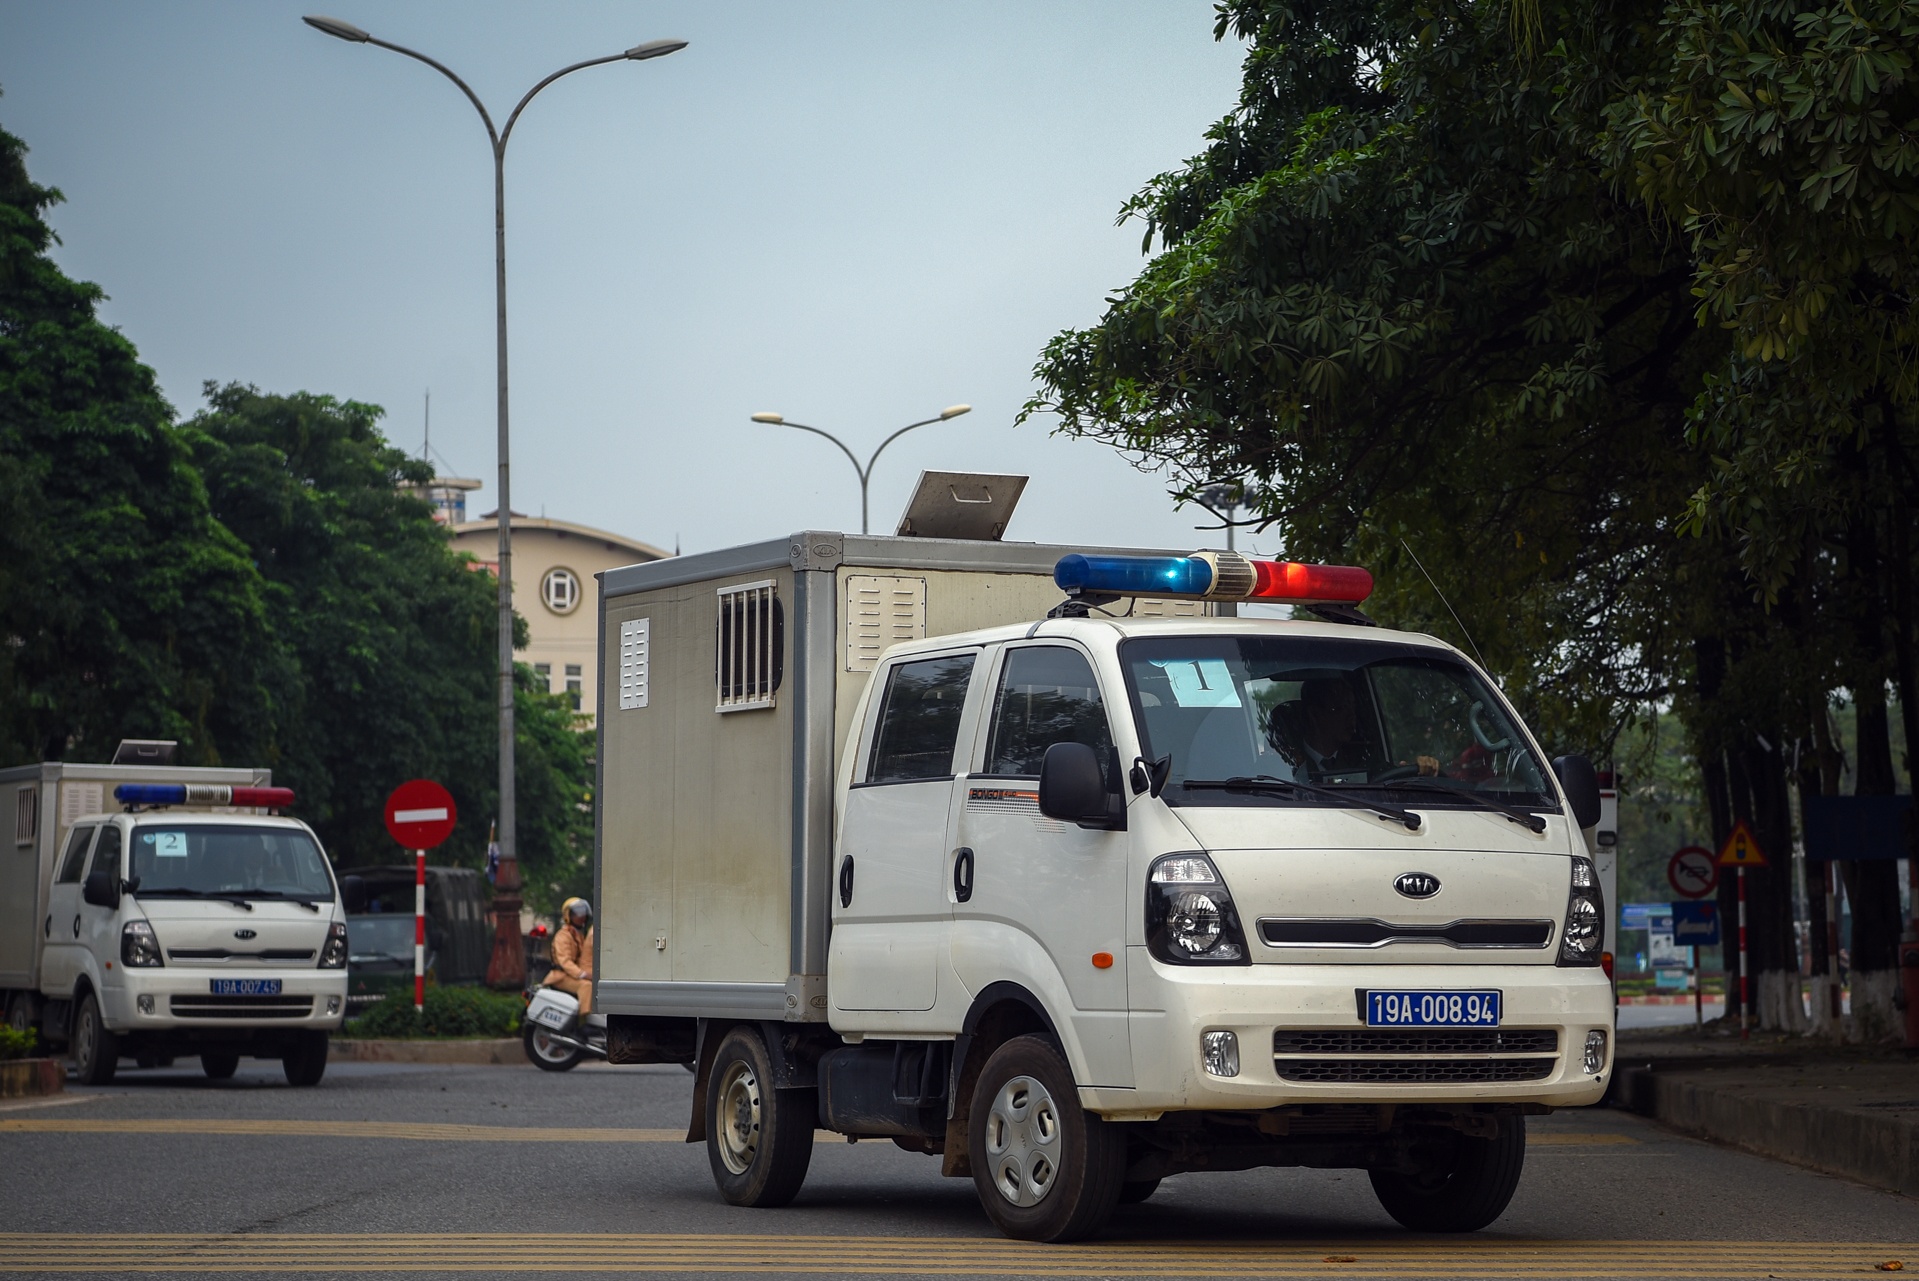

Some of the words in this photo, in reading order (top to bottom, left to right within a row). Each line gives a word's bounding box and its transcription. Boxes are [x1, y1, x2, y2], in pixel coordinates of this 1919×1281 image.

[1188, 660, 1214, 690] 1
[164, 833, 178, 849] 2
[1402, 878, 1434, 891] KIA
[1374, 994, 1494, 1023] 19A-008.94
